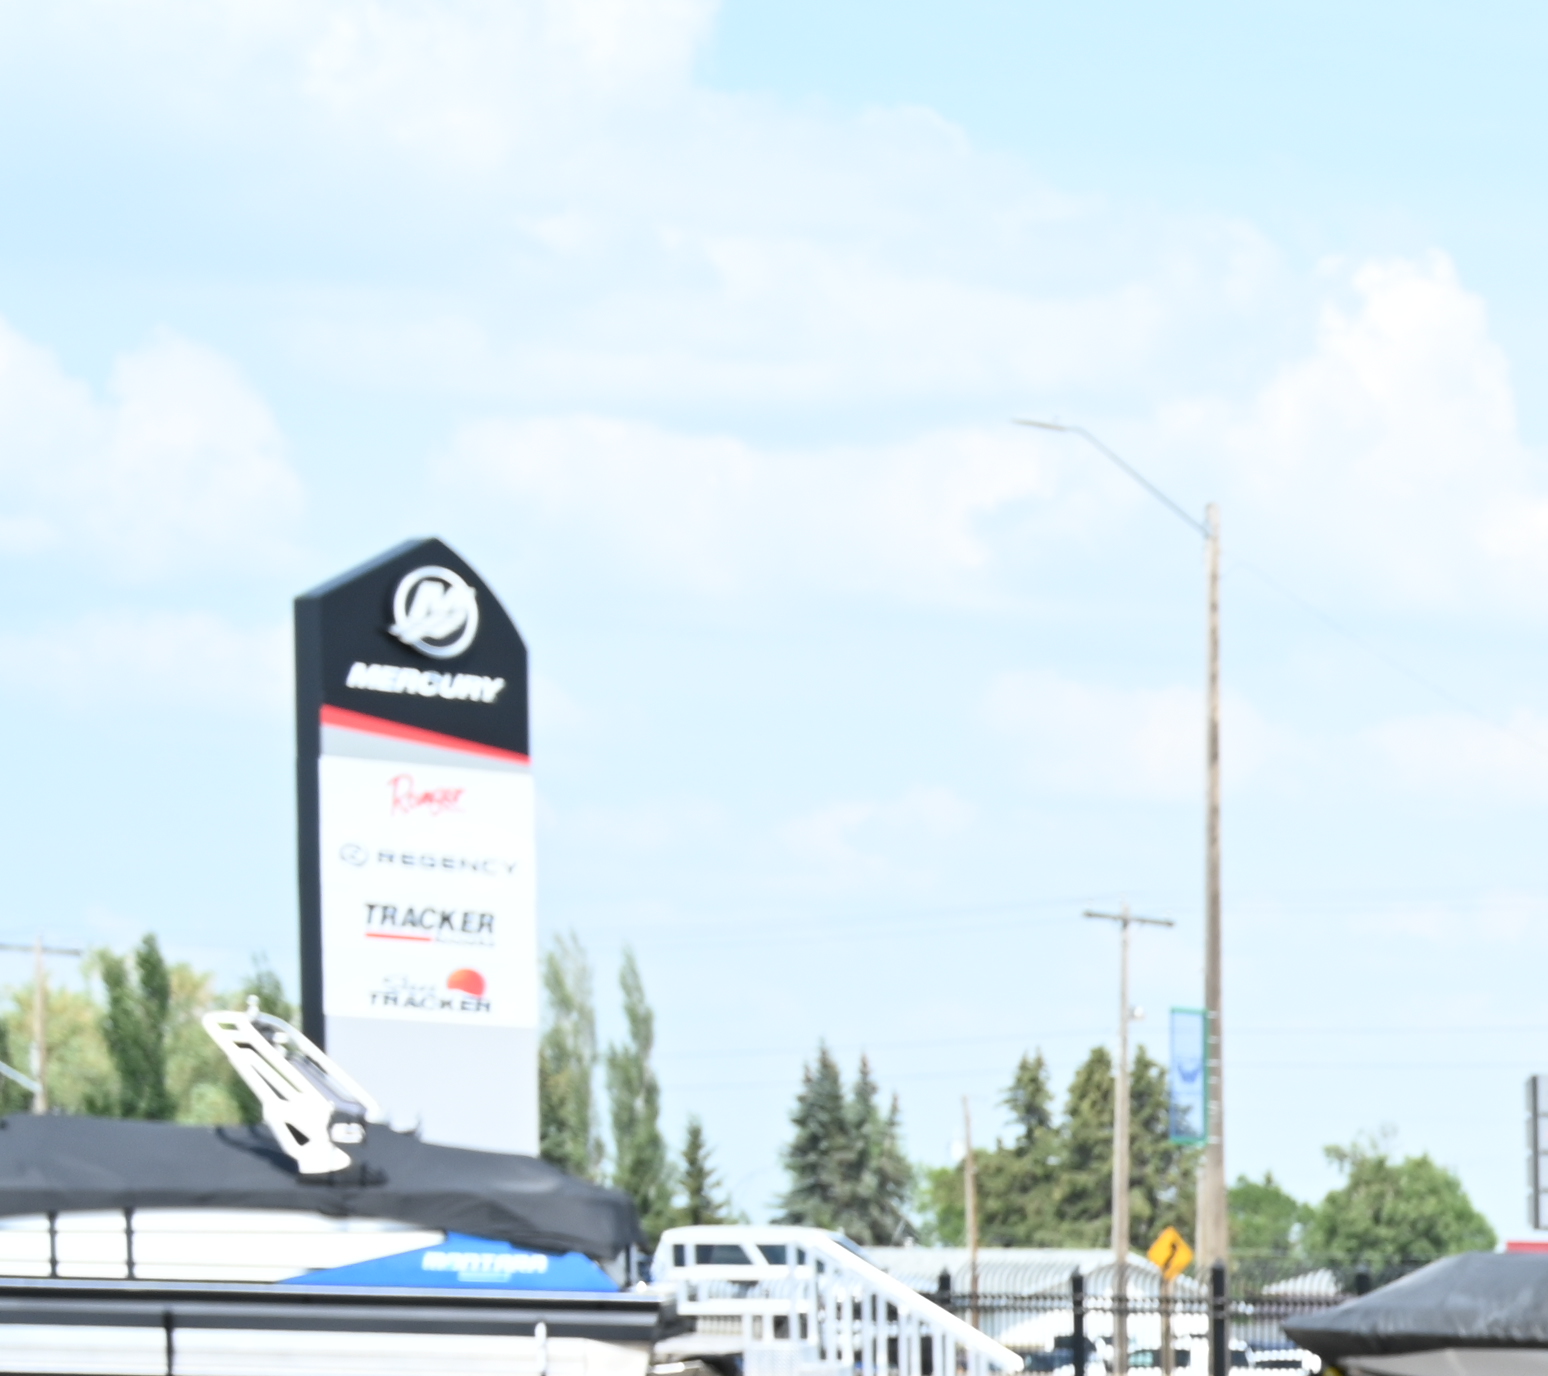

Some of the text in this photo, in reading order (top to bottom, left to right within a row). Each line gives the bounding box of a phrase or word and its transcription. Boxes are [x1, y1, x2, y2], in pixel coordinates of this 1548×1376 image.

[345, 661, 505, 703] MERCURY
[377, 849, 518, 877] REGENCY
[364, 902, 496, 935] TRACKER
